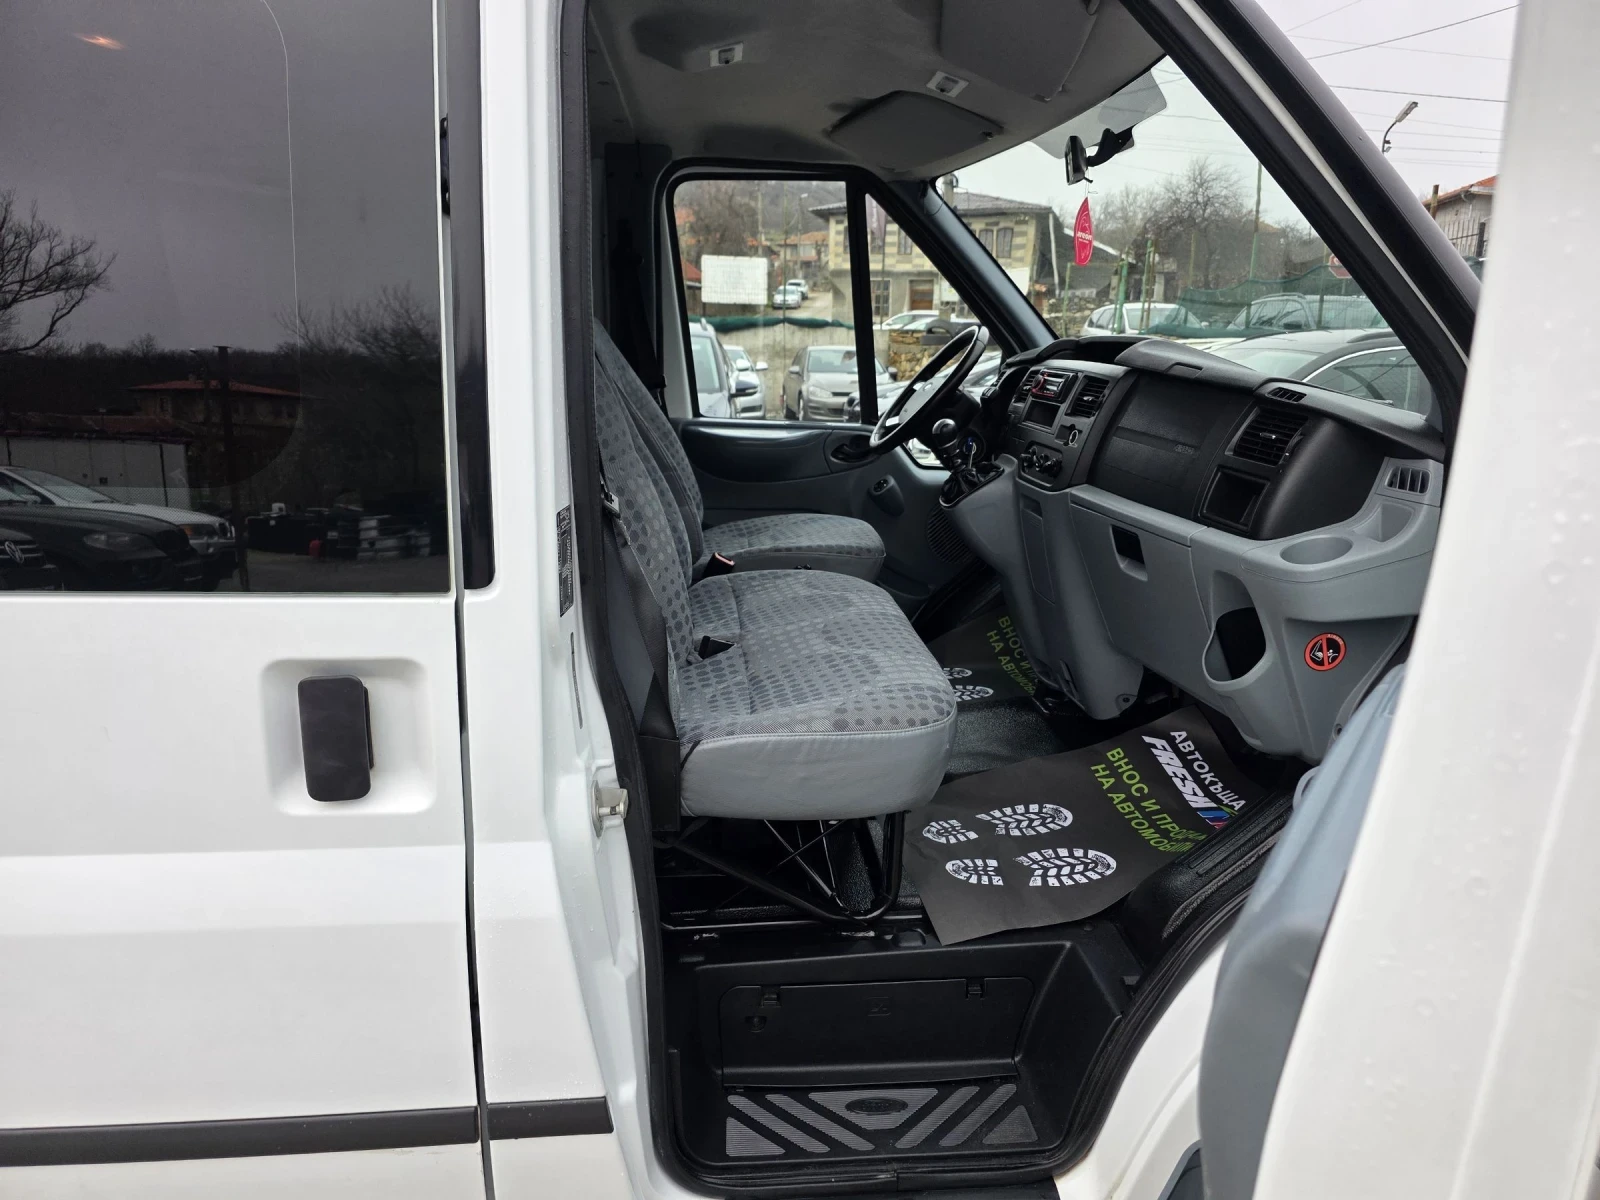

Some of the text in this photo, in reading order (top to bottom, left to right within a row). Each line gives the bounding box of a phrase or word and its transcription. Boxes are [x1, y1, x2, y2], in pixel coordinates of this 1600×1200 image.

[987, 630, 1004, 653] НА
[1091, 764, 1115, 790] НА
[1106, 747, 1149, 797] ВНОС
[1140, 799, 1160, 812] И
[1141, 735, 1218, 808] FRESH
[1170, 731, 1246, 811] АВТОКЪЩА
